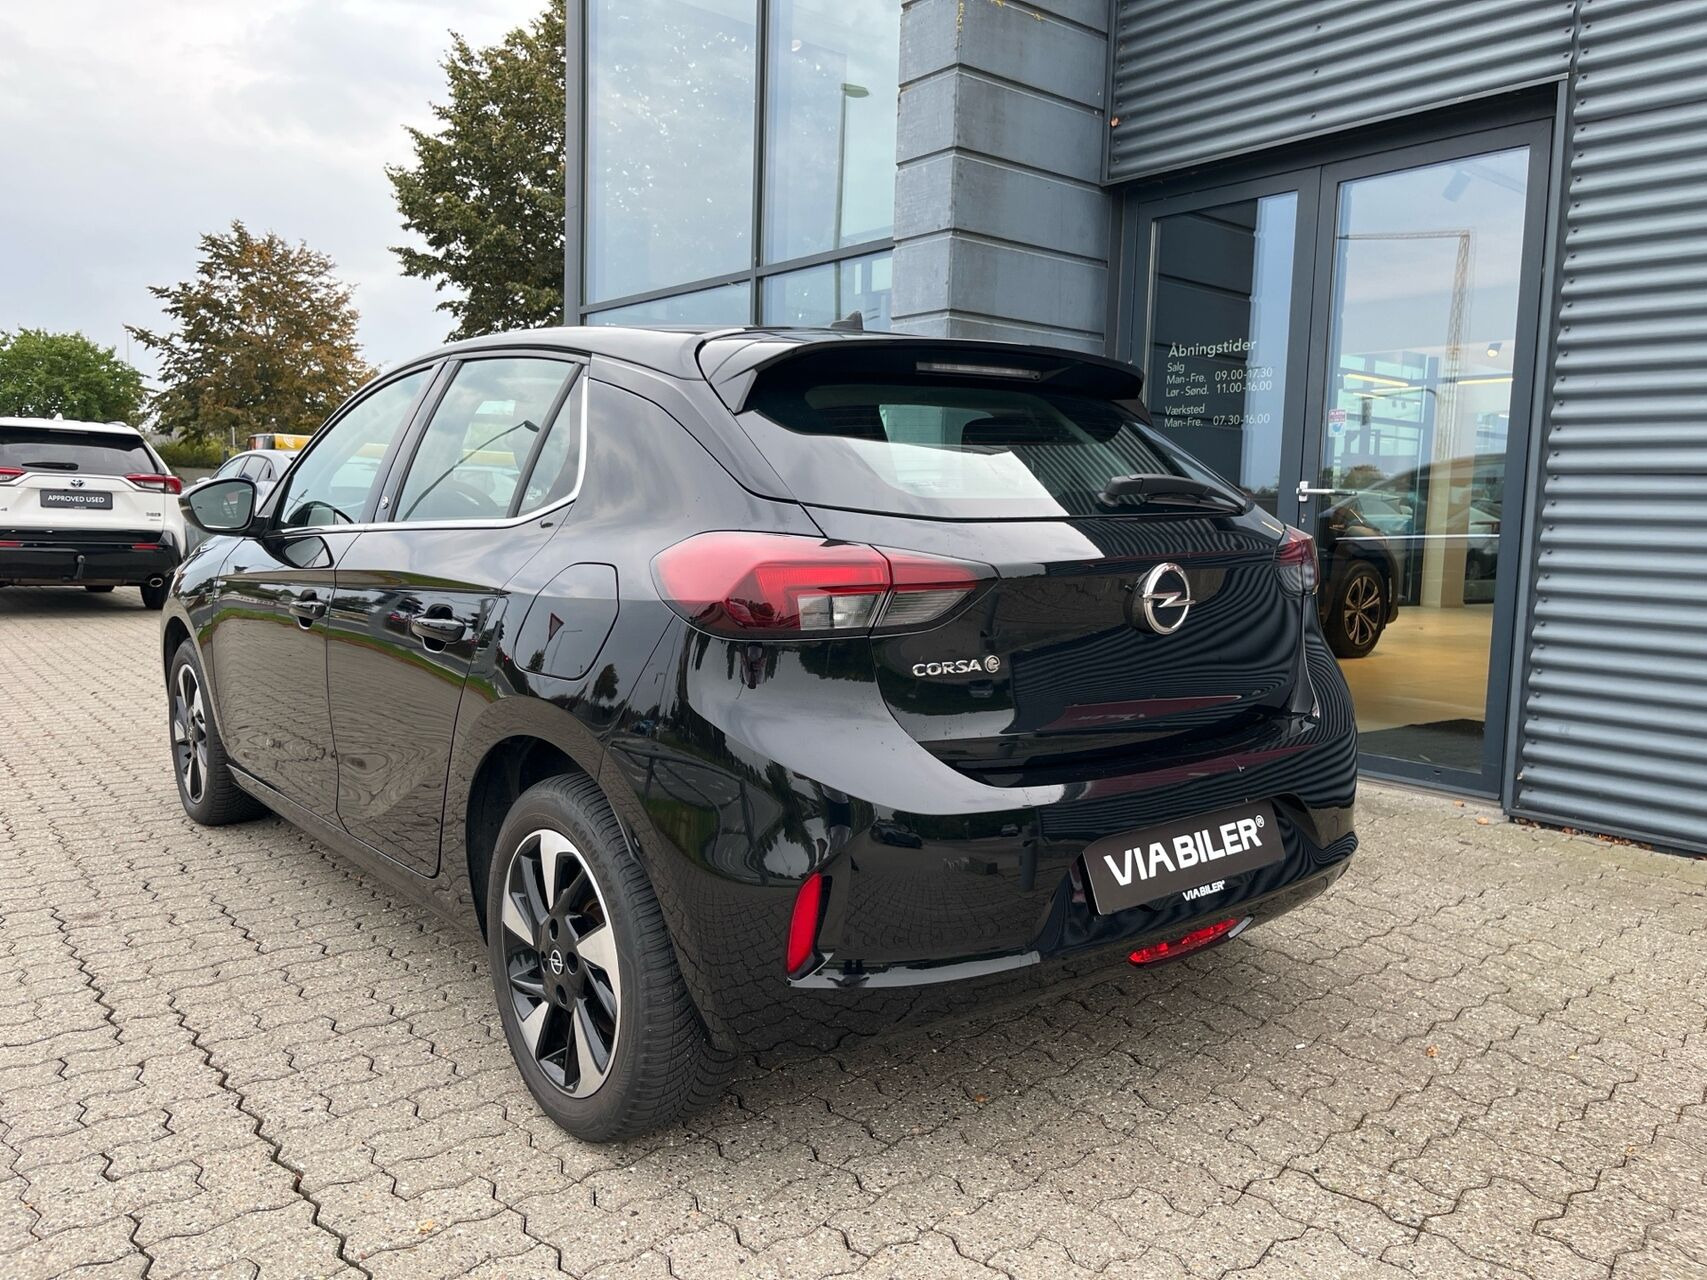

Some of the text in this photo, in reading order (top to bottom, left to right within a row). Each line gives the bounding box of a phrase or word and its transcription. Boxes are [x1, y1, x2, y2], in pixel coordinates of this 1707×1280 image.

[1168, 338, 1257, 358] Åbningstider
[1167, 362, 1185, 374] Salg
[1214, 367, 1273, 382] 09.00-17.30
[1216, 380, 1273, 394] 11.00-16.00
[1165, 403, 1205, 415] Værksted
[1212, 413, 1271, 426] 07.30-16.00
[47, 494, 105, 504] APPROVED USED
[912, 659, 982, 677] CORSA
